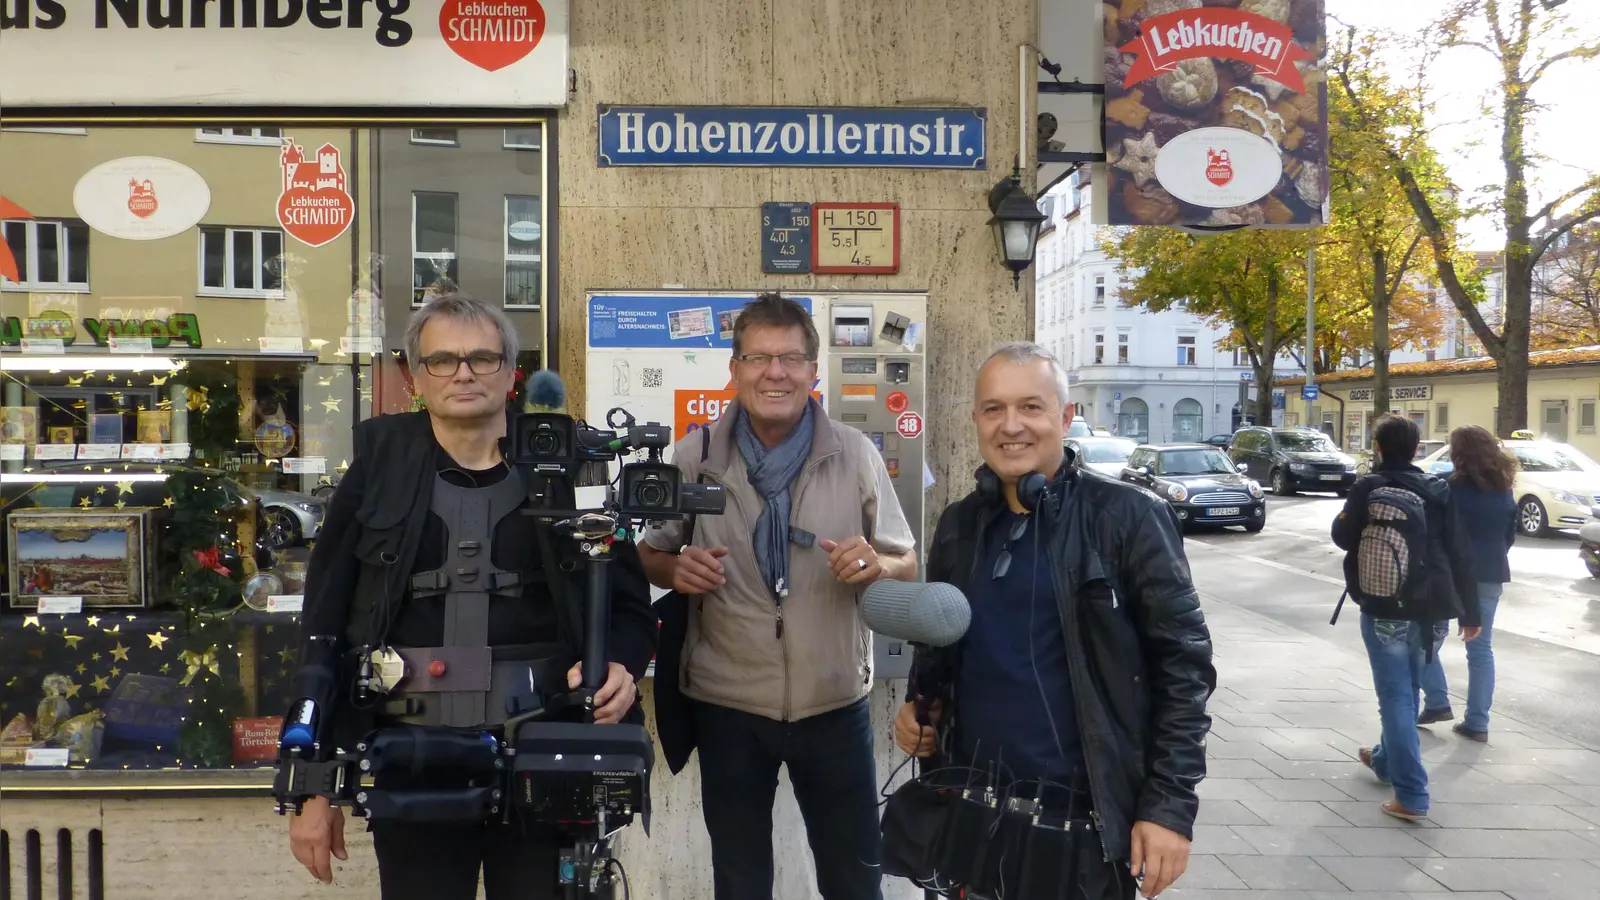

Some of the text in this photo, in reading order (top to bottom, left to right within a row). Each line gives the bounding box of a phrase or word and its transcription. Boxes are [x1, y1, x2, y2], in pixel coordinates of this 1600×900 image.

[458, 2, 527, 16] Lebkuchen
[448, 17, 537, 43] SCHMIDT
[1149, 17, 1282, 60] Lebkuchen
[616, 112, 976, 156] Hohenzollernstr.
[1207, 171, 1231, 179] SCHMIDT
[129, 202, 155, 211] SCHMIDT
[291, 196, 340, 207] Lebkuchen
[284, 207, 347, 225] SCHMIDT
[763, 216, 810, 227] S 150
[823, 211, 877, 226] H 150
[1349, 390, 1370, 400] GLOBE
[1395, 386, 1427, 399] SERVICE
